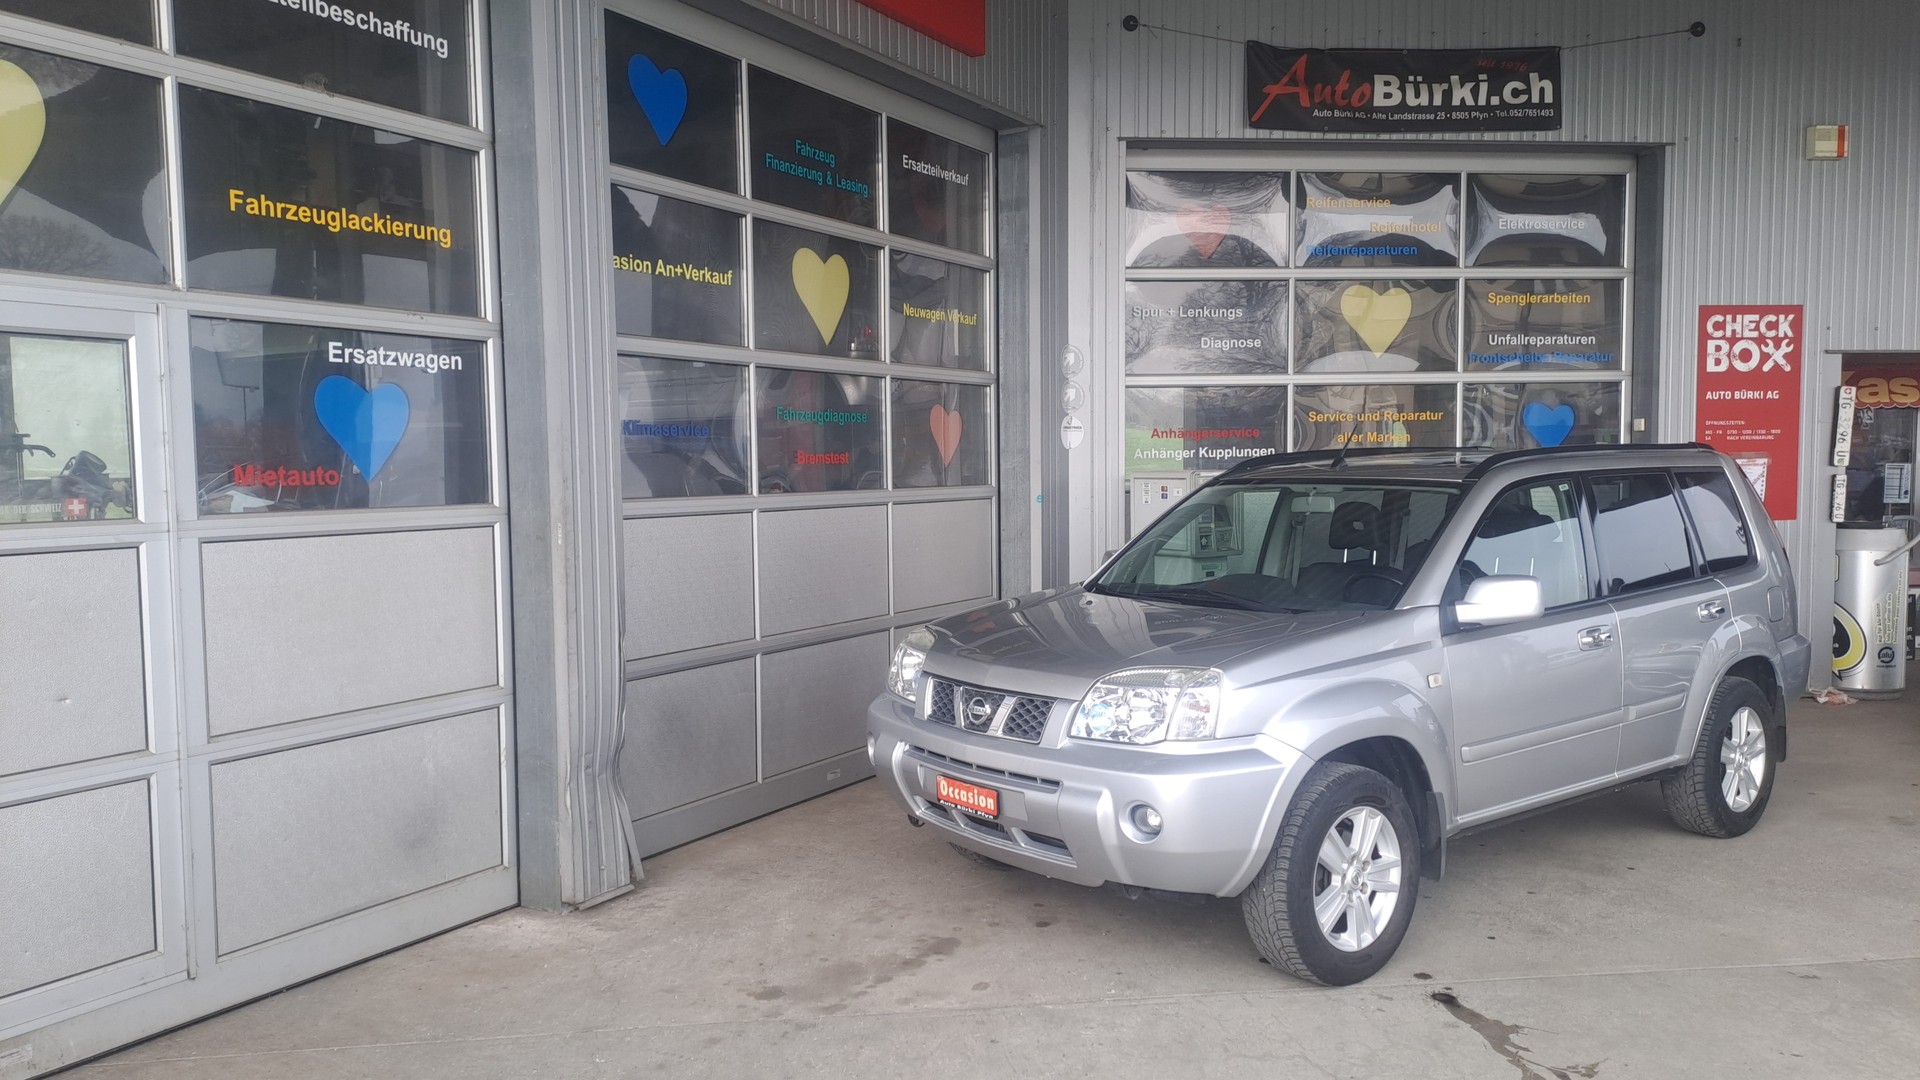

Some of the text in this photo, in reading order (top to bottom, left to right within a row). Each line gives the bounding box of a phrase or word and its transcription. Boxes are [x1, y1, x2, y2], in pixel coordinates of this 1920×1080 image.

[268, 0, 448, 58] eilbeschaffung
[1251, 54, 1554, 122] AutoBürki.ch
[1313, 109, 1332, 117] Auto
[1334, 109, 1353, 118] Bürki
[1372, 112, 1387, 120] Alte
[1389, 112, 1435, 120] Landstrasse
[1436, 112, 1446, 120] 25
[1471, 111, 1488, 120] Pfyn
[795, 139, 836, 168] Fahrzeug
[765, 153, 869, 197] Finanzierung & Leasing
[903, 154, 969, 186] Ersatzteilverkauf
[1307, 197, 1391, 209] Reifenservice
[229, 189, 451, 248] Fahrzeuglackierung
[1498, 218, 1586, 231] Elektroservice
[1370, 222, 1442, 233] Reifenhotel
[1307, 244, 1418, 257] Reifenreparaturen
[655, 259, 733, 285] An+Verkauf
[1487, 292, 1591, 307] Spenglerarbeiten
[903, 303, 977, 325] Neuwagen Verkauf
[1132, 306, 1243, 320] Spur + Lenkungs
[1706, 314, 1795, 338] CHECK
[1201, 337, 1262, 350] Diagnose
[1488, 334, 1596, 347] Unfallreparaturen
[328, 341, 463, 374] Ersatzwagen
[1552, 351, 1615, 364] Reparatur
[1706, 339, 1794, 372] BOX
[1706, 389, 1779, 400] AUTO BÜRKI AG
[776, 406, 868, 425] Fahrzeugdiagnose
[1308, 410, 1444, 423] Service und Reparatur
[622, 419, 710, 438] Klimaservice
[1151, 428, 1261, 442] Anhängerservice
[1367, 432, 1411, 443] Marken
[796, 450, 849, 465] Bremstest
[1134, 446, 1275, 460] Anhänger Kupplungen
[234, 465, 340, 488] Mietauto
[1881, 650, 1892, 659] alu
[940, 780, 995, 810] Occasion
[940, 800, 956, 808] Auto
[957, 804, 976, 814] Bürki
